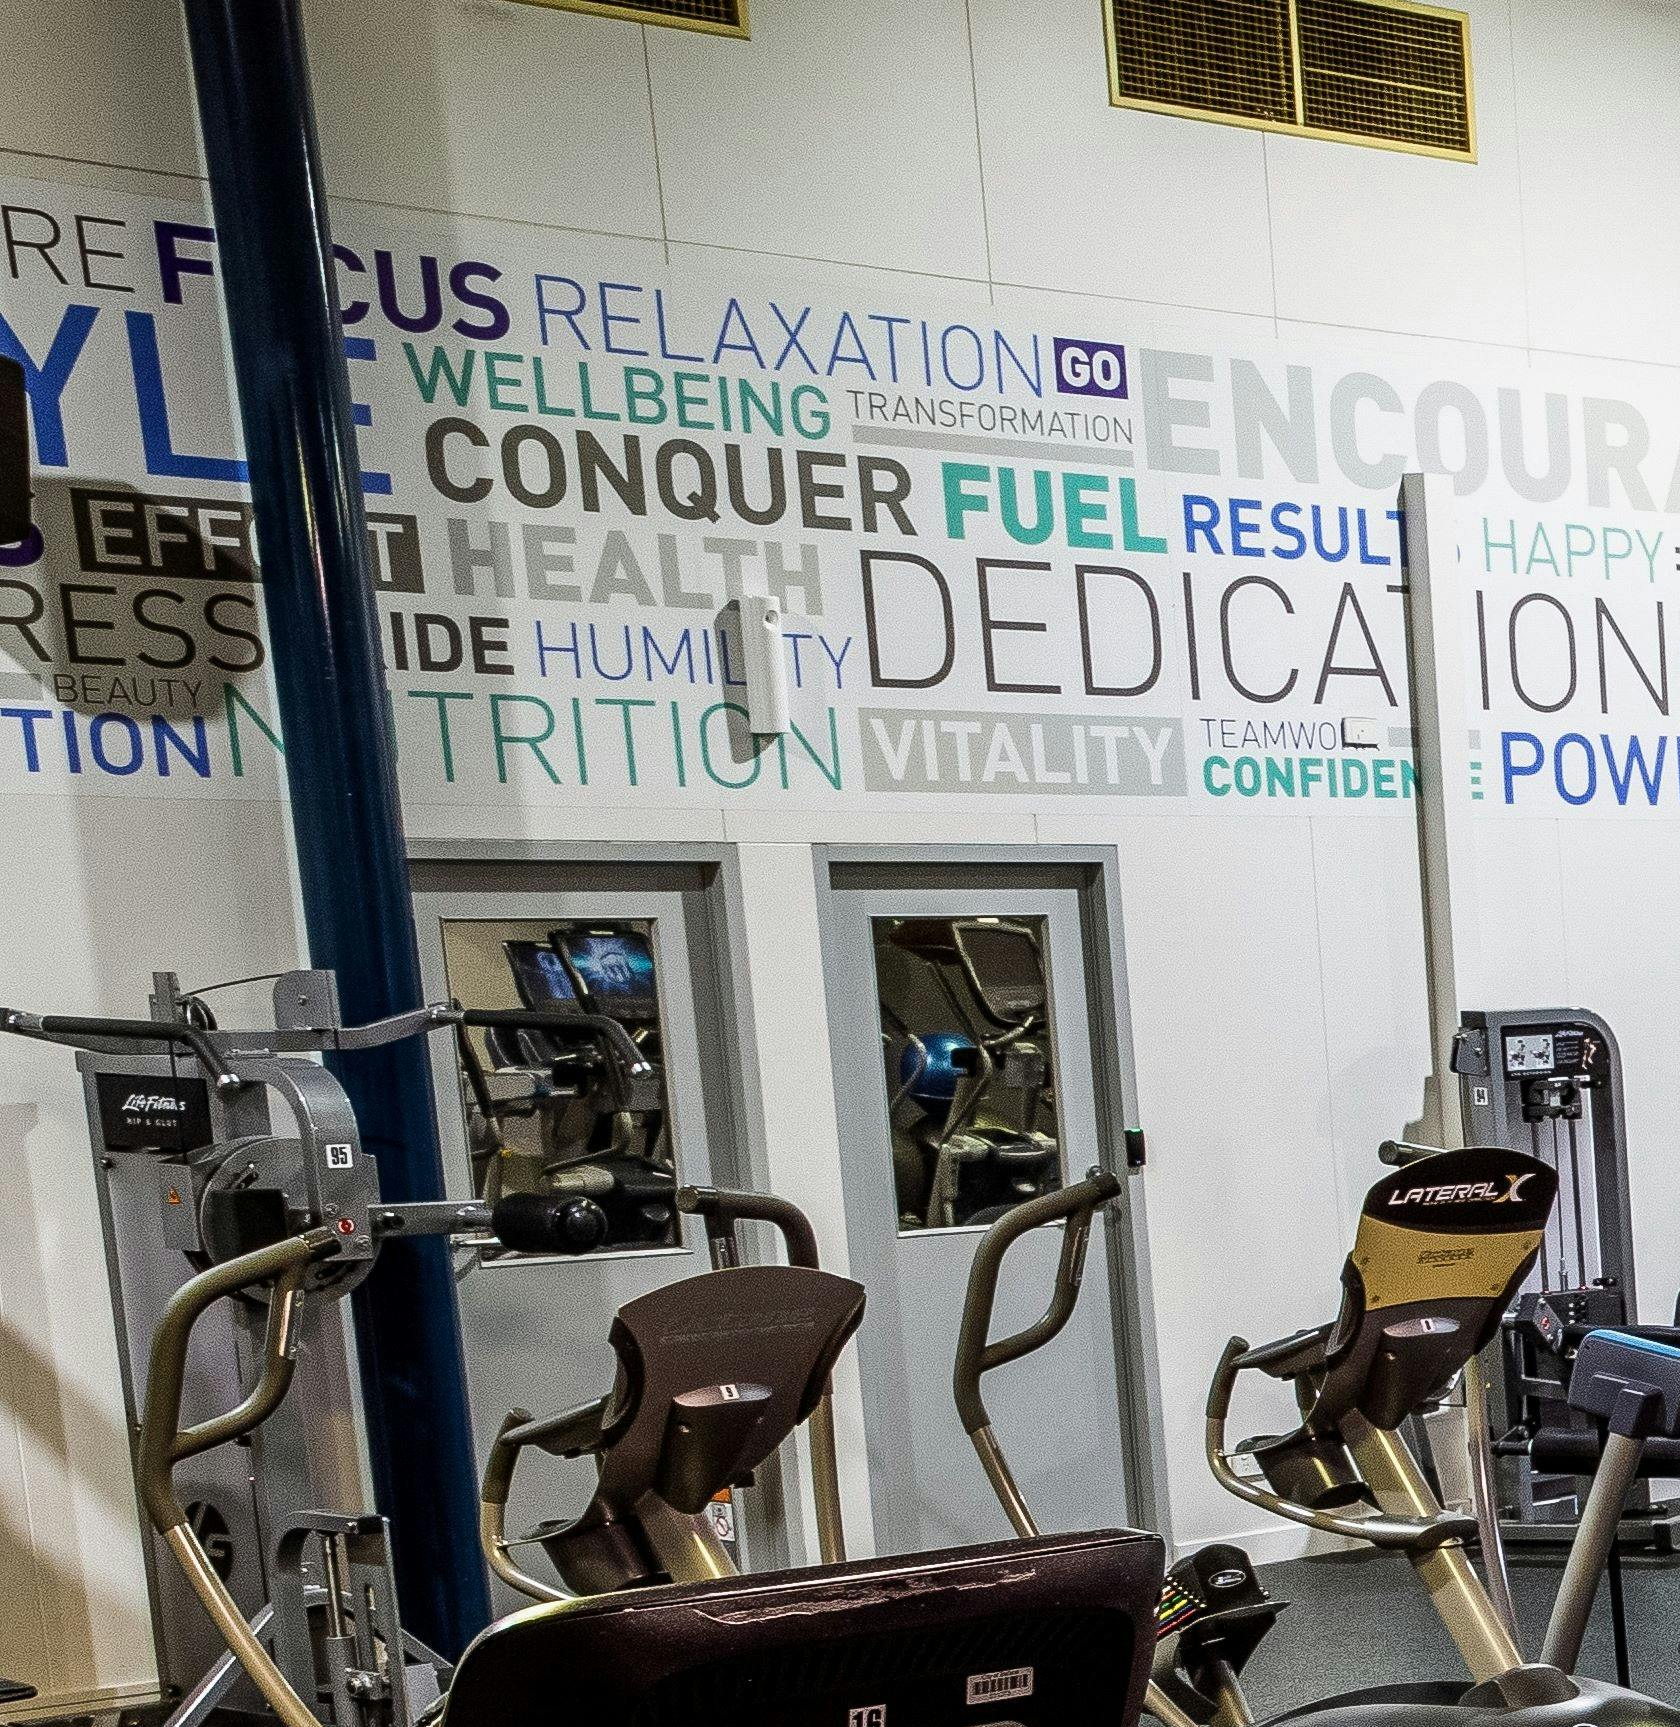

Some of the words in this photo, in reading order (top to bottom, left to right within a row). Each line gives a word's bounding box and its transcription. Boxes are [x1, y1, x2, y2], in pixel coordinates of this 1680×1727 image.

[153, 220, 510, 340] FCUS
[535, 274, 1044, 398] RELAXATION
[1060, 345, 1124, 391] GO
[403, 343, 830, 440] WELLBEING
[846, 390, 1133, 444] TRANSFORMATION
[426, 417, 916, 535] CONQUER
[942, 462, 1167, 554] FUEL
[449, 518, 823, 615] HEALTH
[1483, 517, 1664, 583] HAPPY
[862, 550, 1670, 716] DEDICAION
[55, 674, 203, 711] BEAUTY
[872, 719, 1174, 788] VITALITY
[330, 1147, 348, 1165] 95
